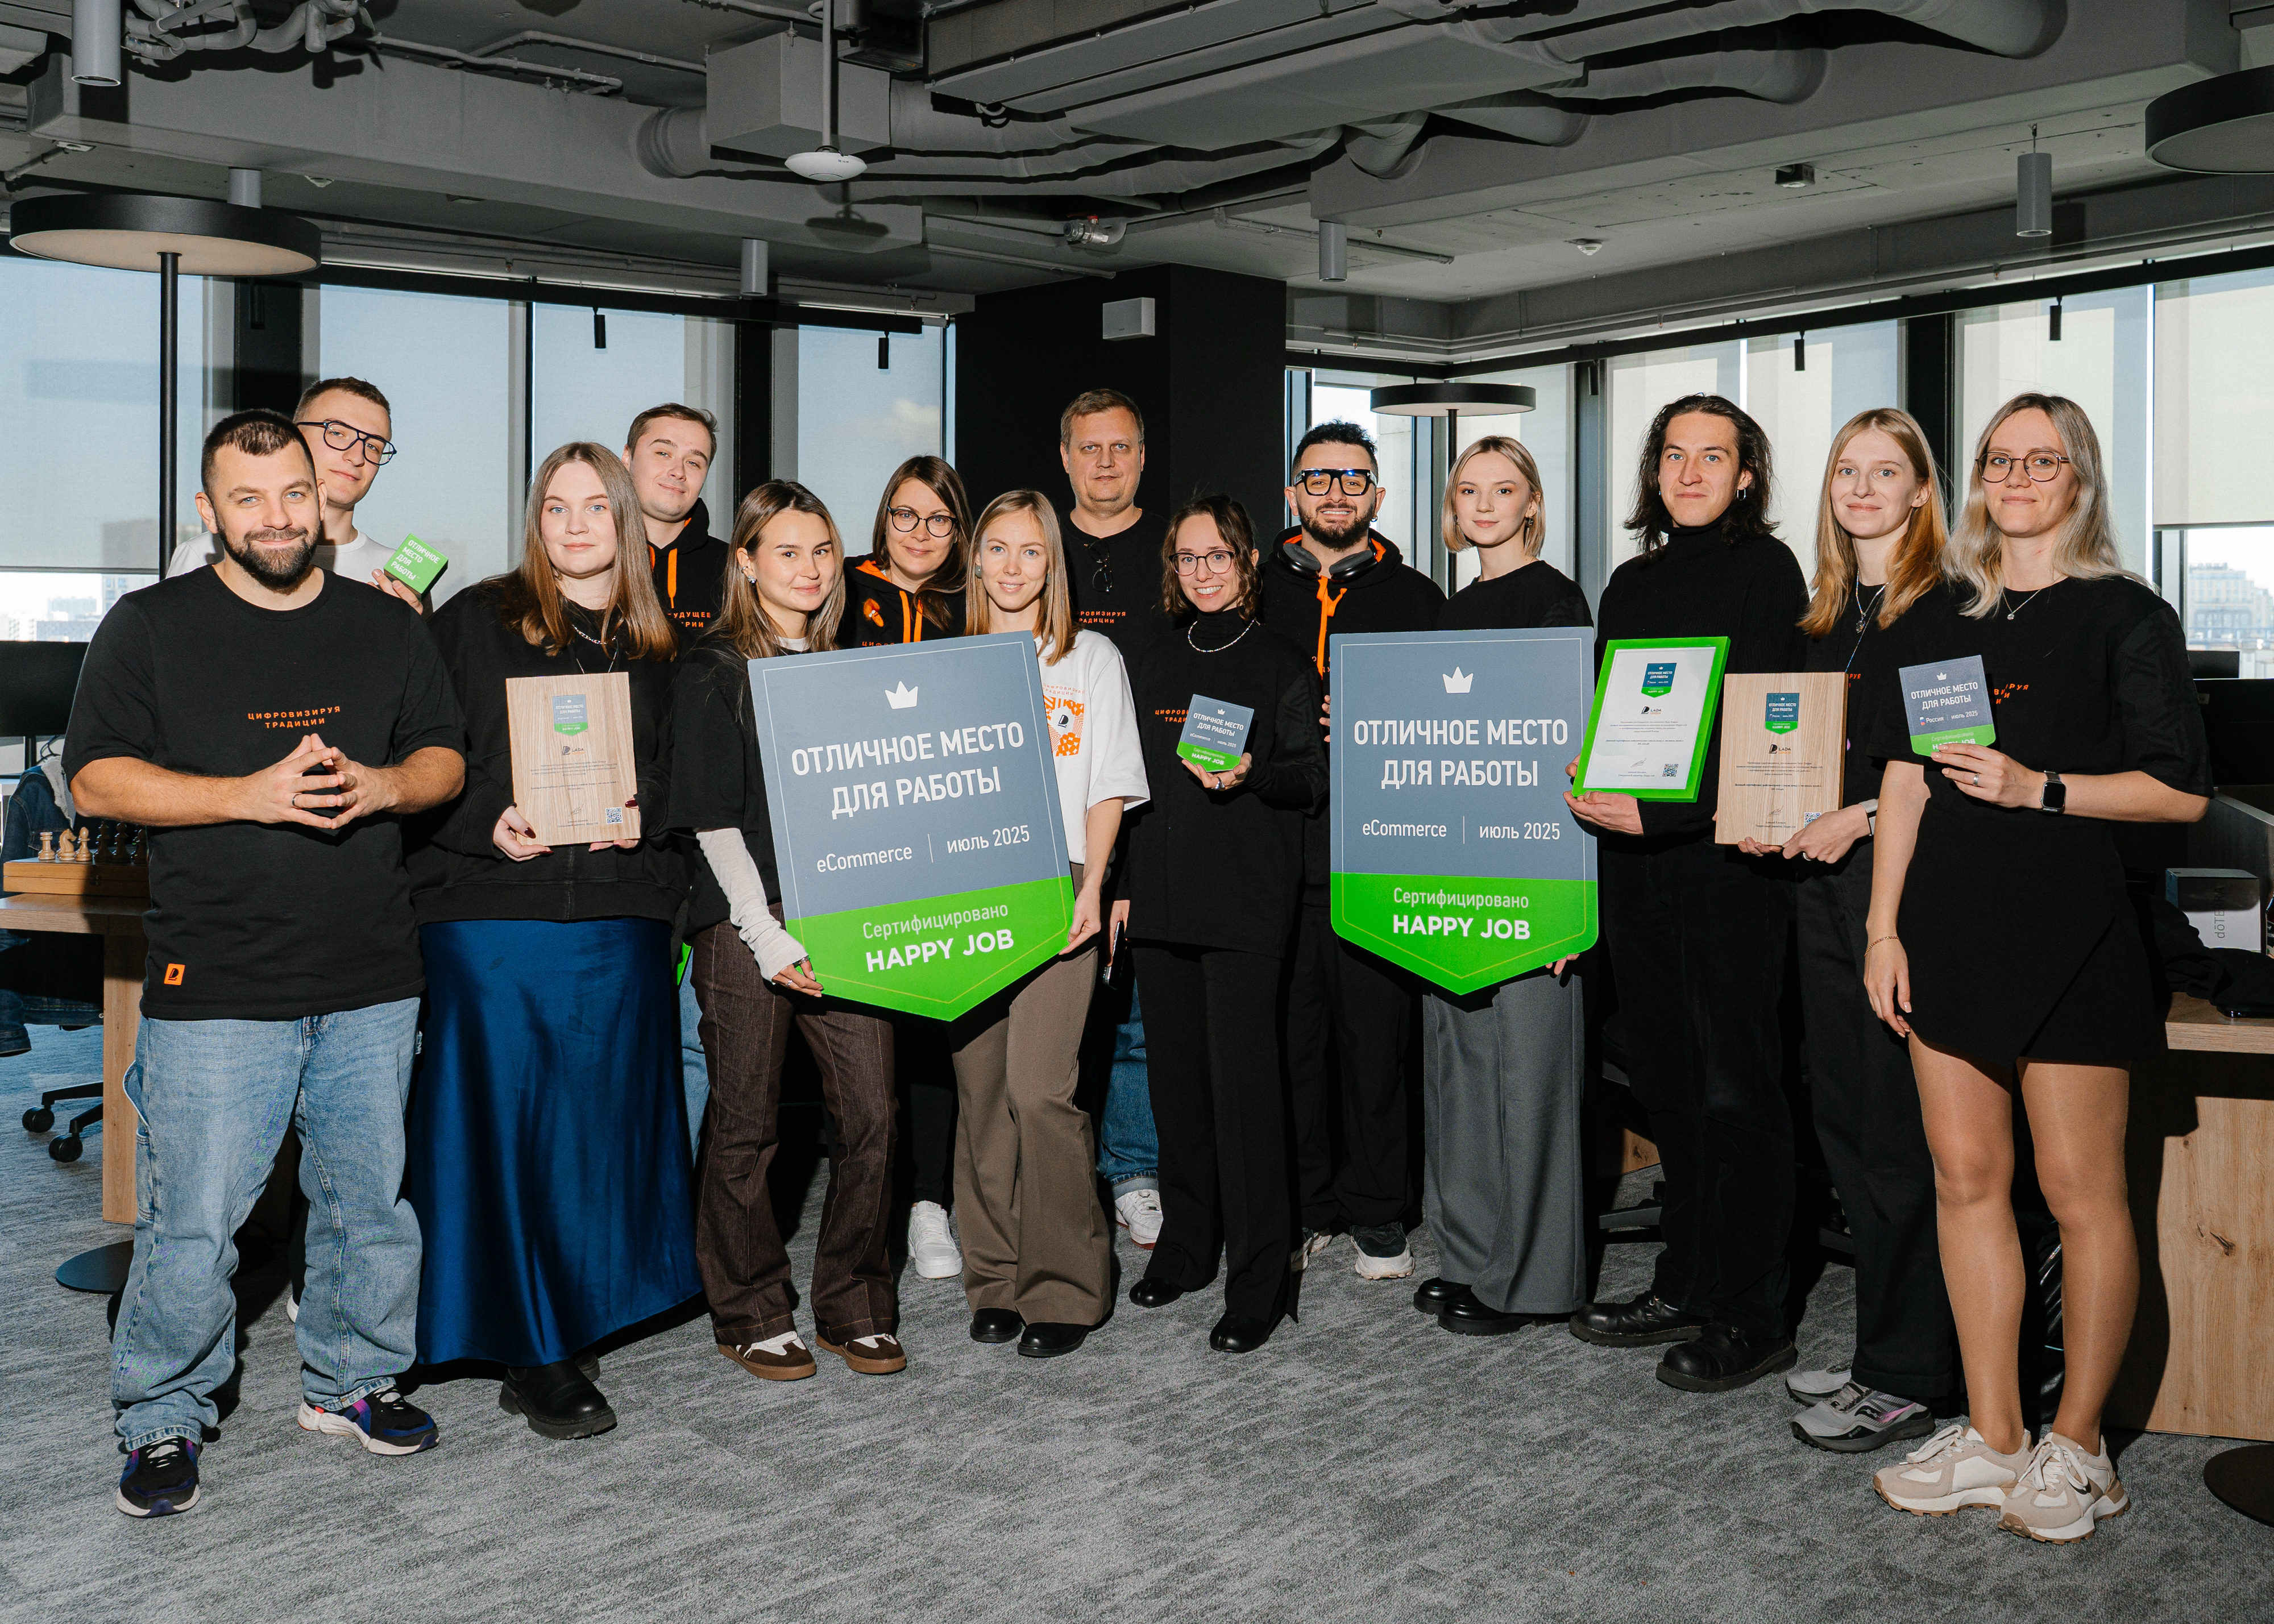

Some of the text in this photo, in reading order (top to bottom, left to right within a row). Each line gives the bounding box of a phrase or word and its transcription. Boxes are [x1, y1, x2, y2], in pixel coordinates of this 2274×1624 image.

[396, 554, 412, 566] ДЛЯ
[402, 547, 424, 563] МЕСТО
[408, 540, 441, 564] ОТЛИЧНОЕ
[391, 561, 416, 580] РАБОТЫ
[1911, 682, 1978, 699] ОТЛИЧНОЕ МЕСТО
[248, 706, 341, 720] ЦИФРОВИЗИРУЯ
[1922, 695, 1972, 711] ДЛЯ РАБОТЫ
[265, 718, 325, 728] ТРАДИЦИИ
[1193, 712, 1244, 730] ОТЛИЧНОЕ МЕСТО
[1197, 722, 1235, 737] ДЛЯ РАБОТЫ
[1190, 733, 1211, 741] eCommerce
[1354, 719, 1568, 746] ОТЛИЧНОЕ МЕСТО
[791, 722, 1024, 775] ОТЛИЧНОЕ МЕСТО
[1192, 753, 1212, 762] HAPPY
[1381, 760, 1538, 790] ДЛЯ РАБОТЫ
[831, 766, 1001, 820] ДЛЯ РАБОТЫ
[1362, 819, 1561, 840] eCommerce июль 2025
[817, 825, 1030, 873] eCommerce июль 2025
[1393, 887, 1529, 911] Сертифицировано
[862, 904, 1009, 941] Сертифицировано
[1393, 915, 1530, 940] HAPPY JOB
[866, 929, 1014, 973] HAPPY JOB
